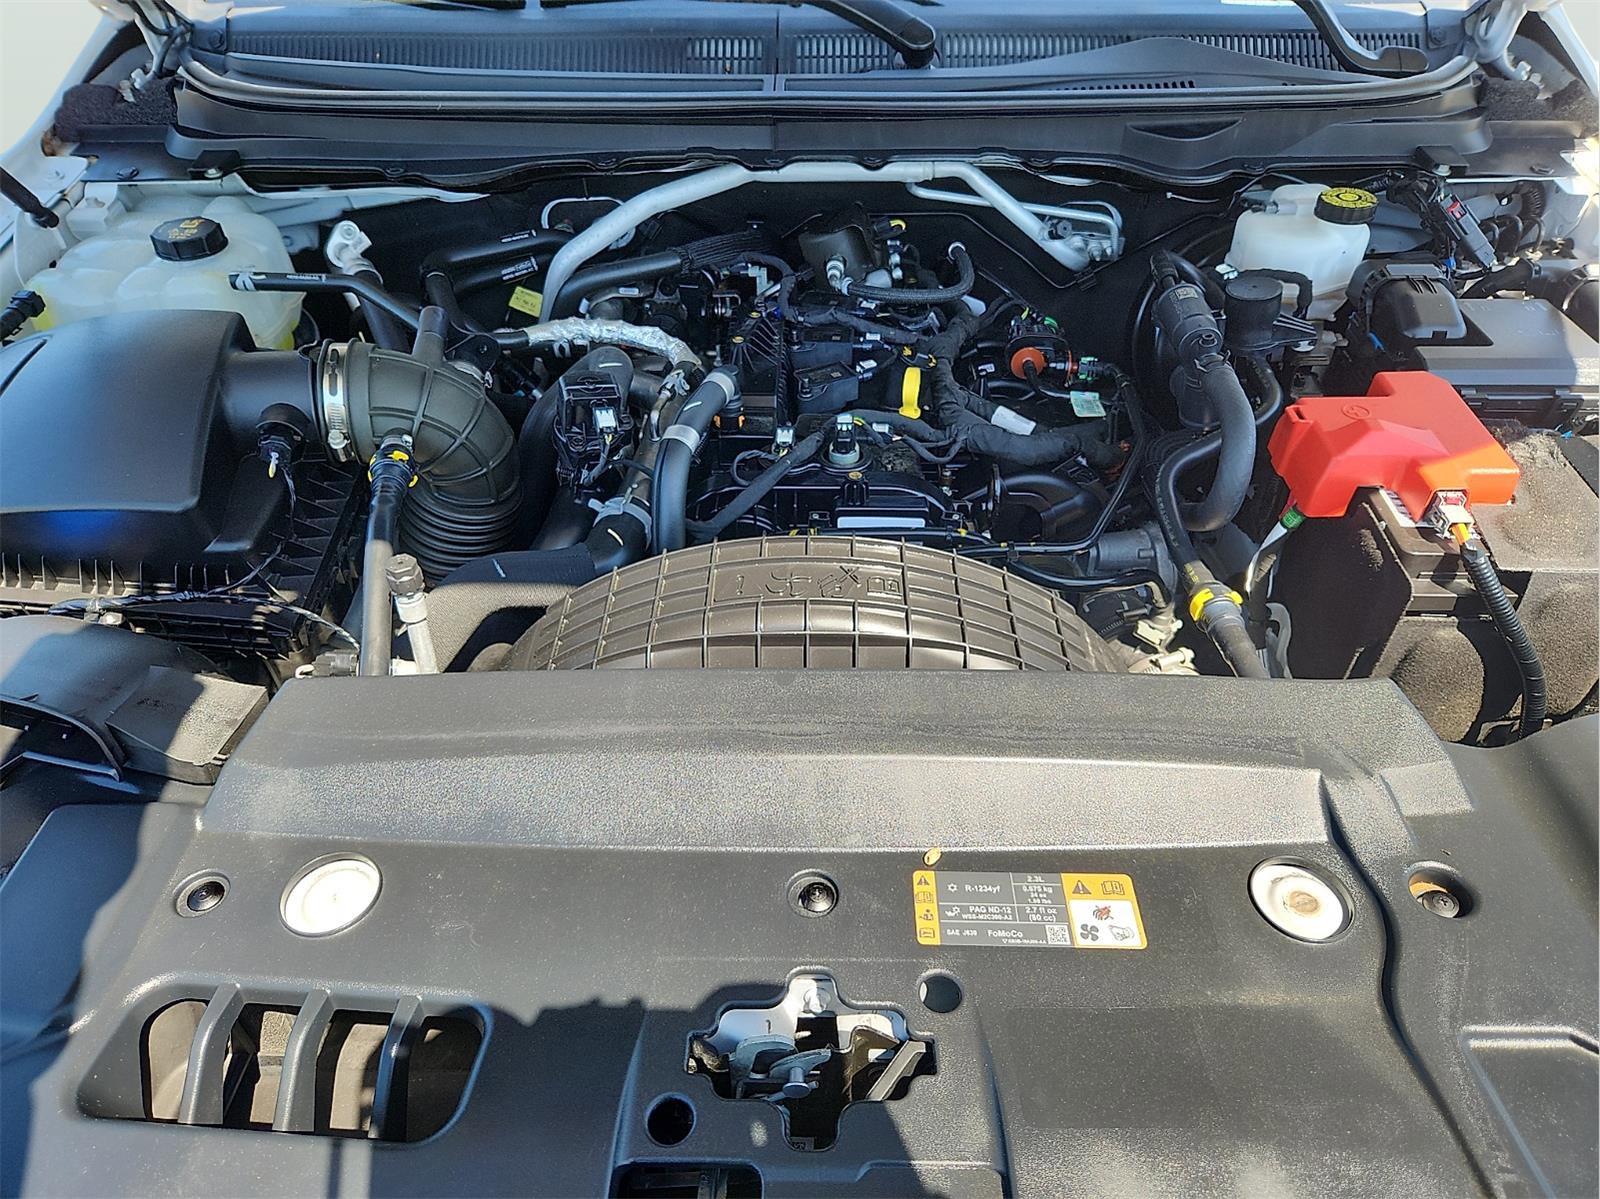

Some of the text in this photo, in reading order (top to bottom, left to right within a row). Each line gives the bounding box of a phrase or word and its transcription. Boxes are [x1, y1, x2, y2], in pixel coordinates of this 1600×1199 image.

[964, 884, 1001, 894] R-1234yf
[968, 905, 1012, 914] PAG ND-12
[1025, 906, 1037, 914] 2.7
[987, 929, 1024, 938] FoMoCo
